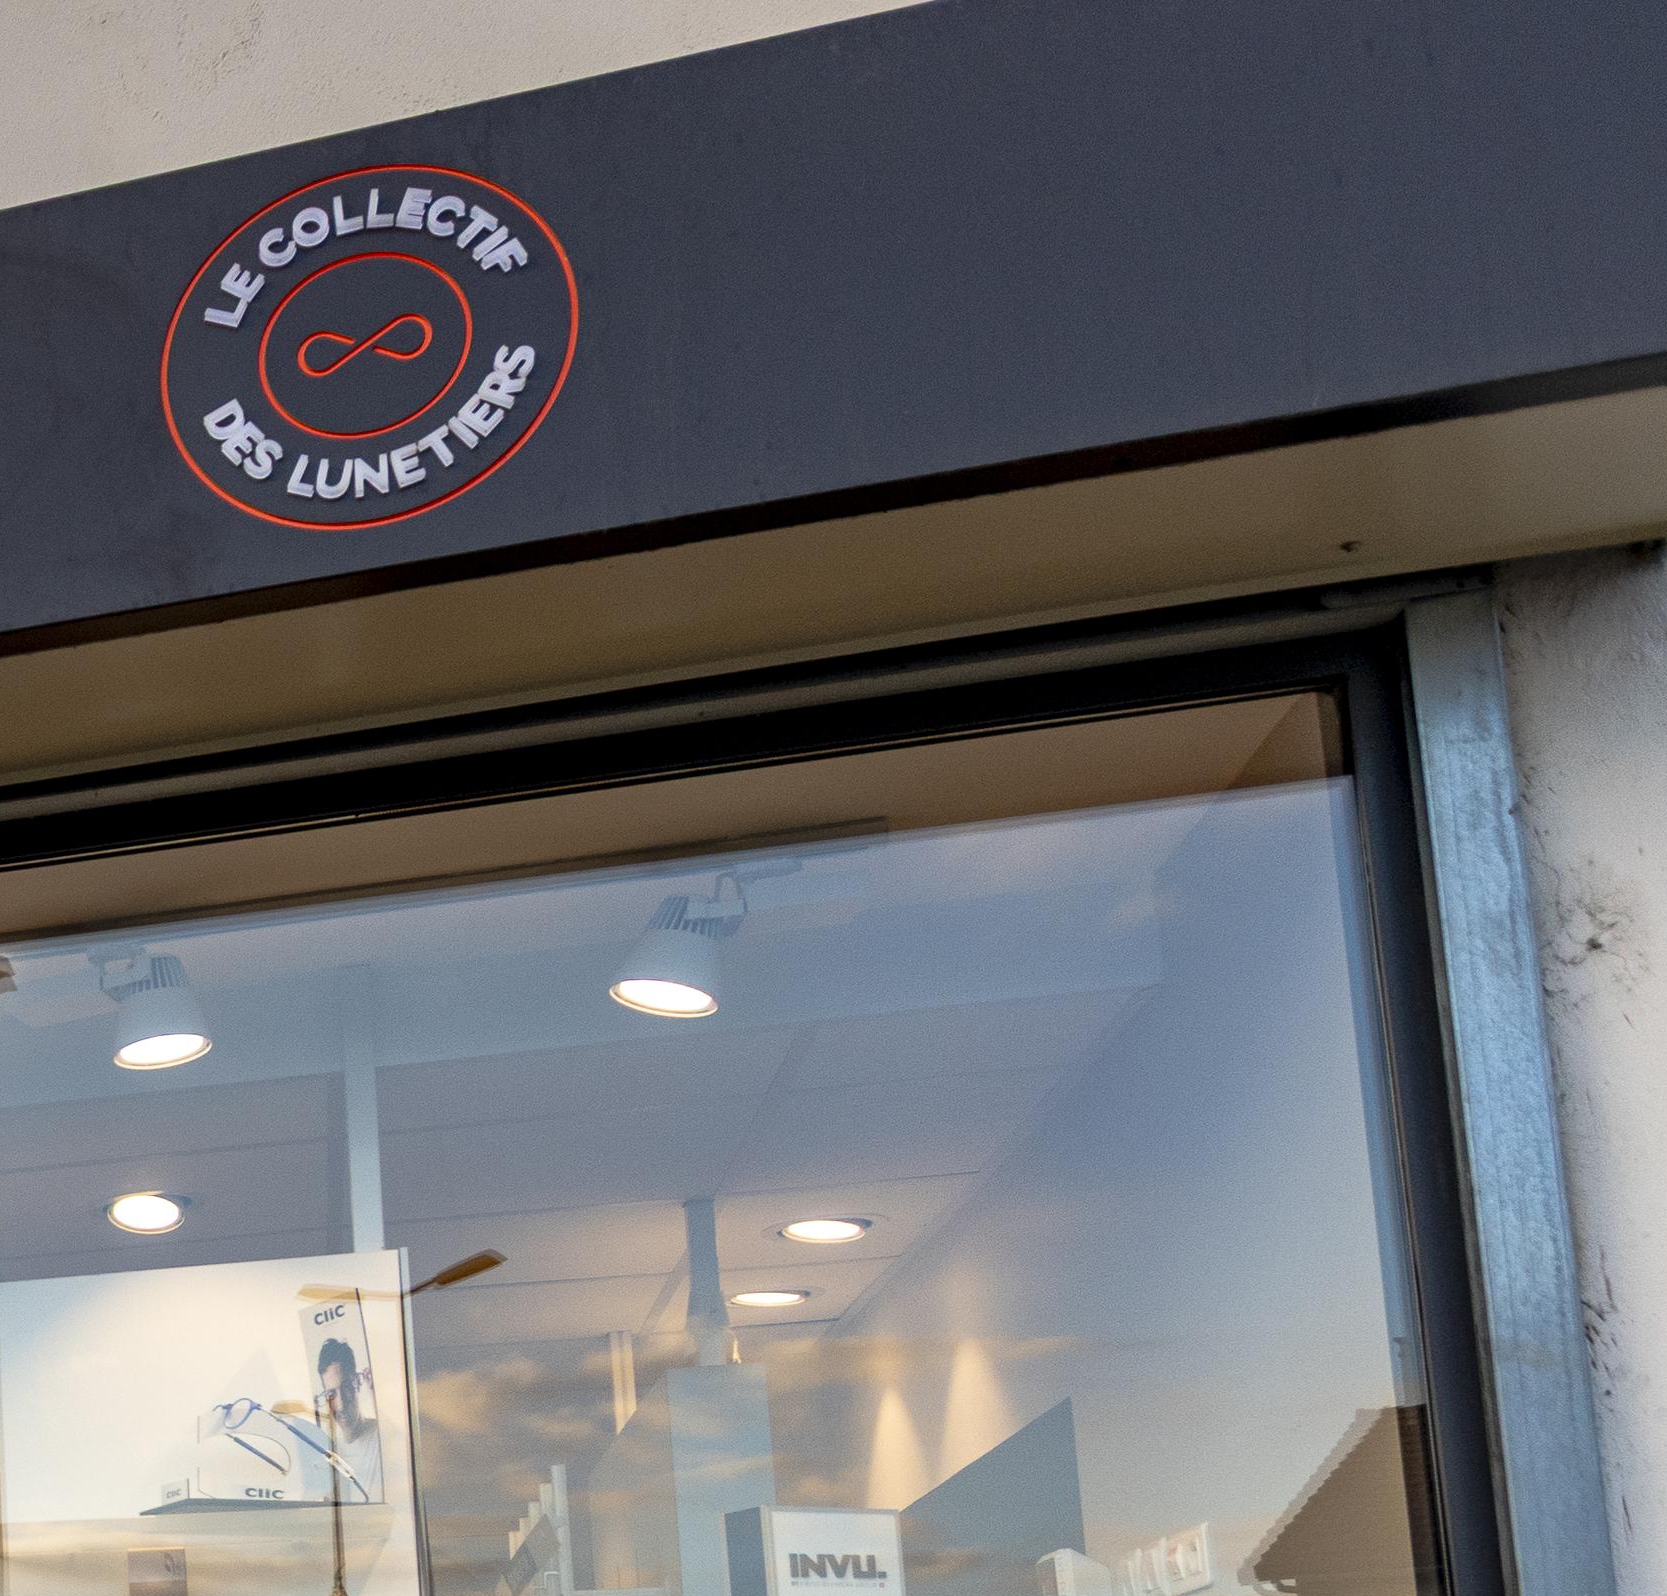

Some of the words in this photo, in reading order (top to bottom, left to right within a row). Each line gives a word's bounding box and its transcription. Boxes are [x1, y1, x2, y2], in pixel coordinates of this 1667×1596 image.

[204, 263, 265, 328] LE
[259, 187, 528, 272] COLLECTIF
[203, 398, 283, 479] DES
[287, 344, 535, 499] LUNETIERS
